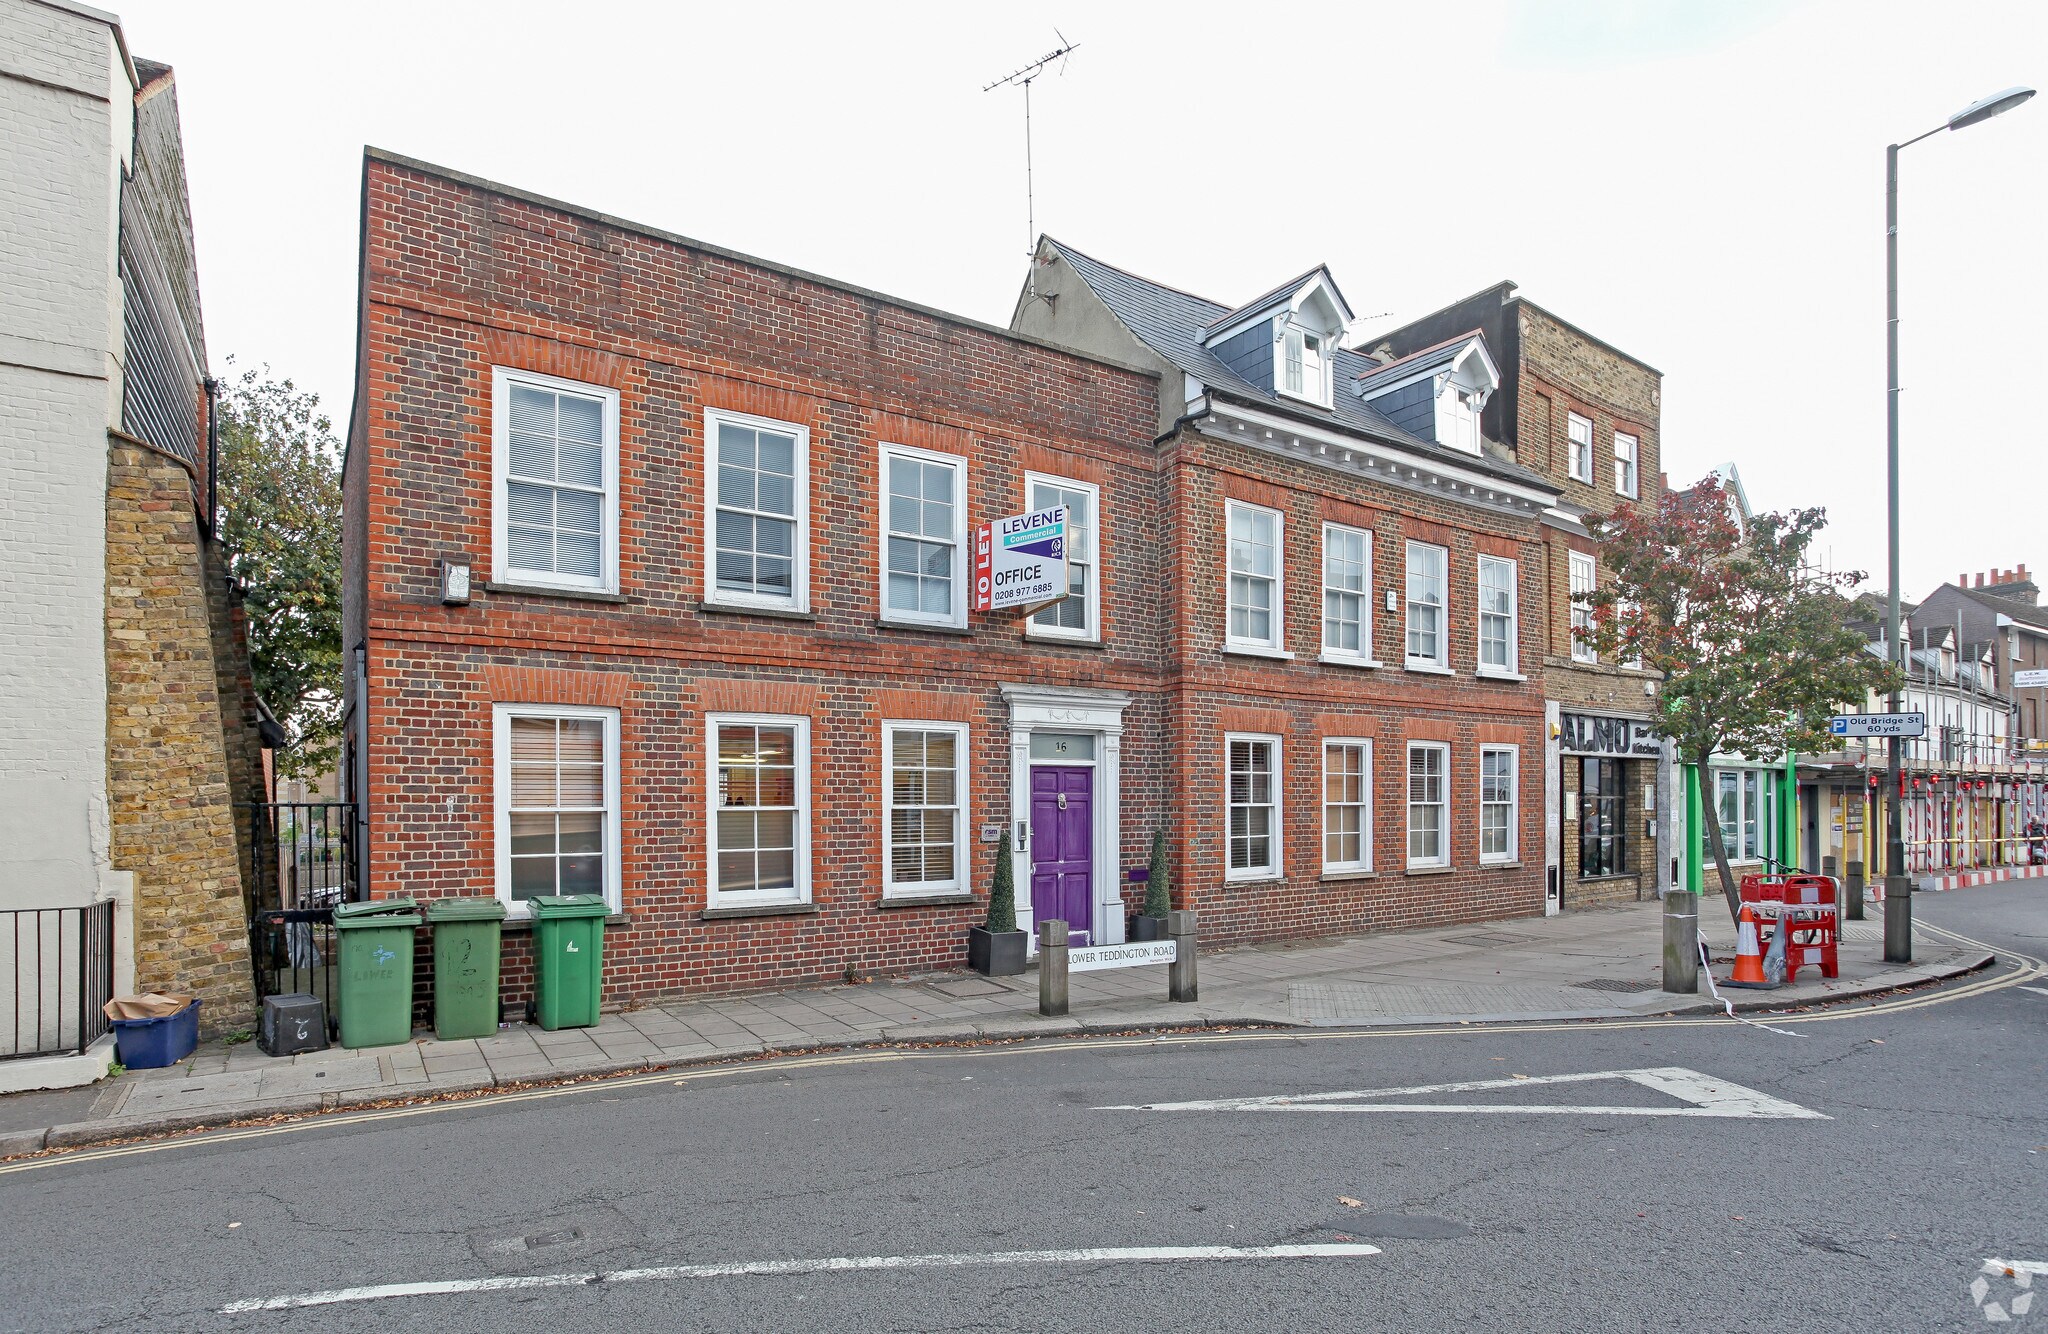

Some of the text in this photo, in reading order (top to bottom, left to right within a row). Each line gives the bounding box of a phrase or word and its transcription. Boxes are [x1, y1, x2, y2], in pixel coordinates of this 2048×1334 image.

[1003, 509, 1063, 534] LEVENE
[1010, 527, 1056, 543] Commercial
[978, 527, 990, 609] TO LET
[995, 564, 1041, 586] OFFICE
[995, 583, 1052, 600] 0208 977 6885
[1850, 717, 1867, 725] Old
[1871, 717, 1903, 725] Bridge
[1883, 725, 1900, 733] yds
[1560, 713, 1630, 754] ALMO
[1055, 742, 1067, 752] 16
[1632, 742, 1660, 755] Kitchen
[1068, 945, 1175, 965] LOWER TEDDINGTON ROAD
